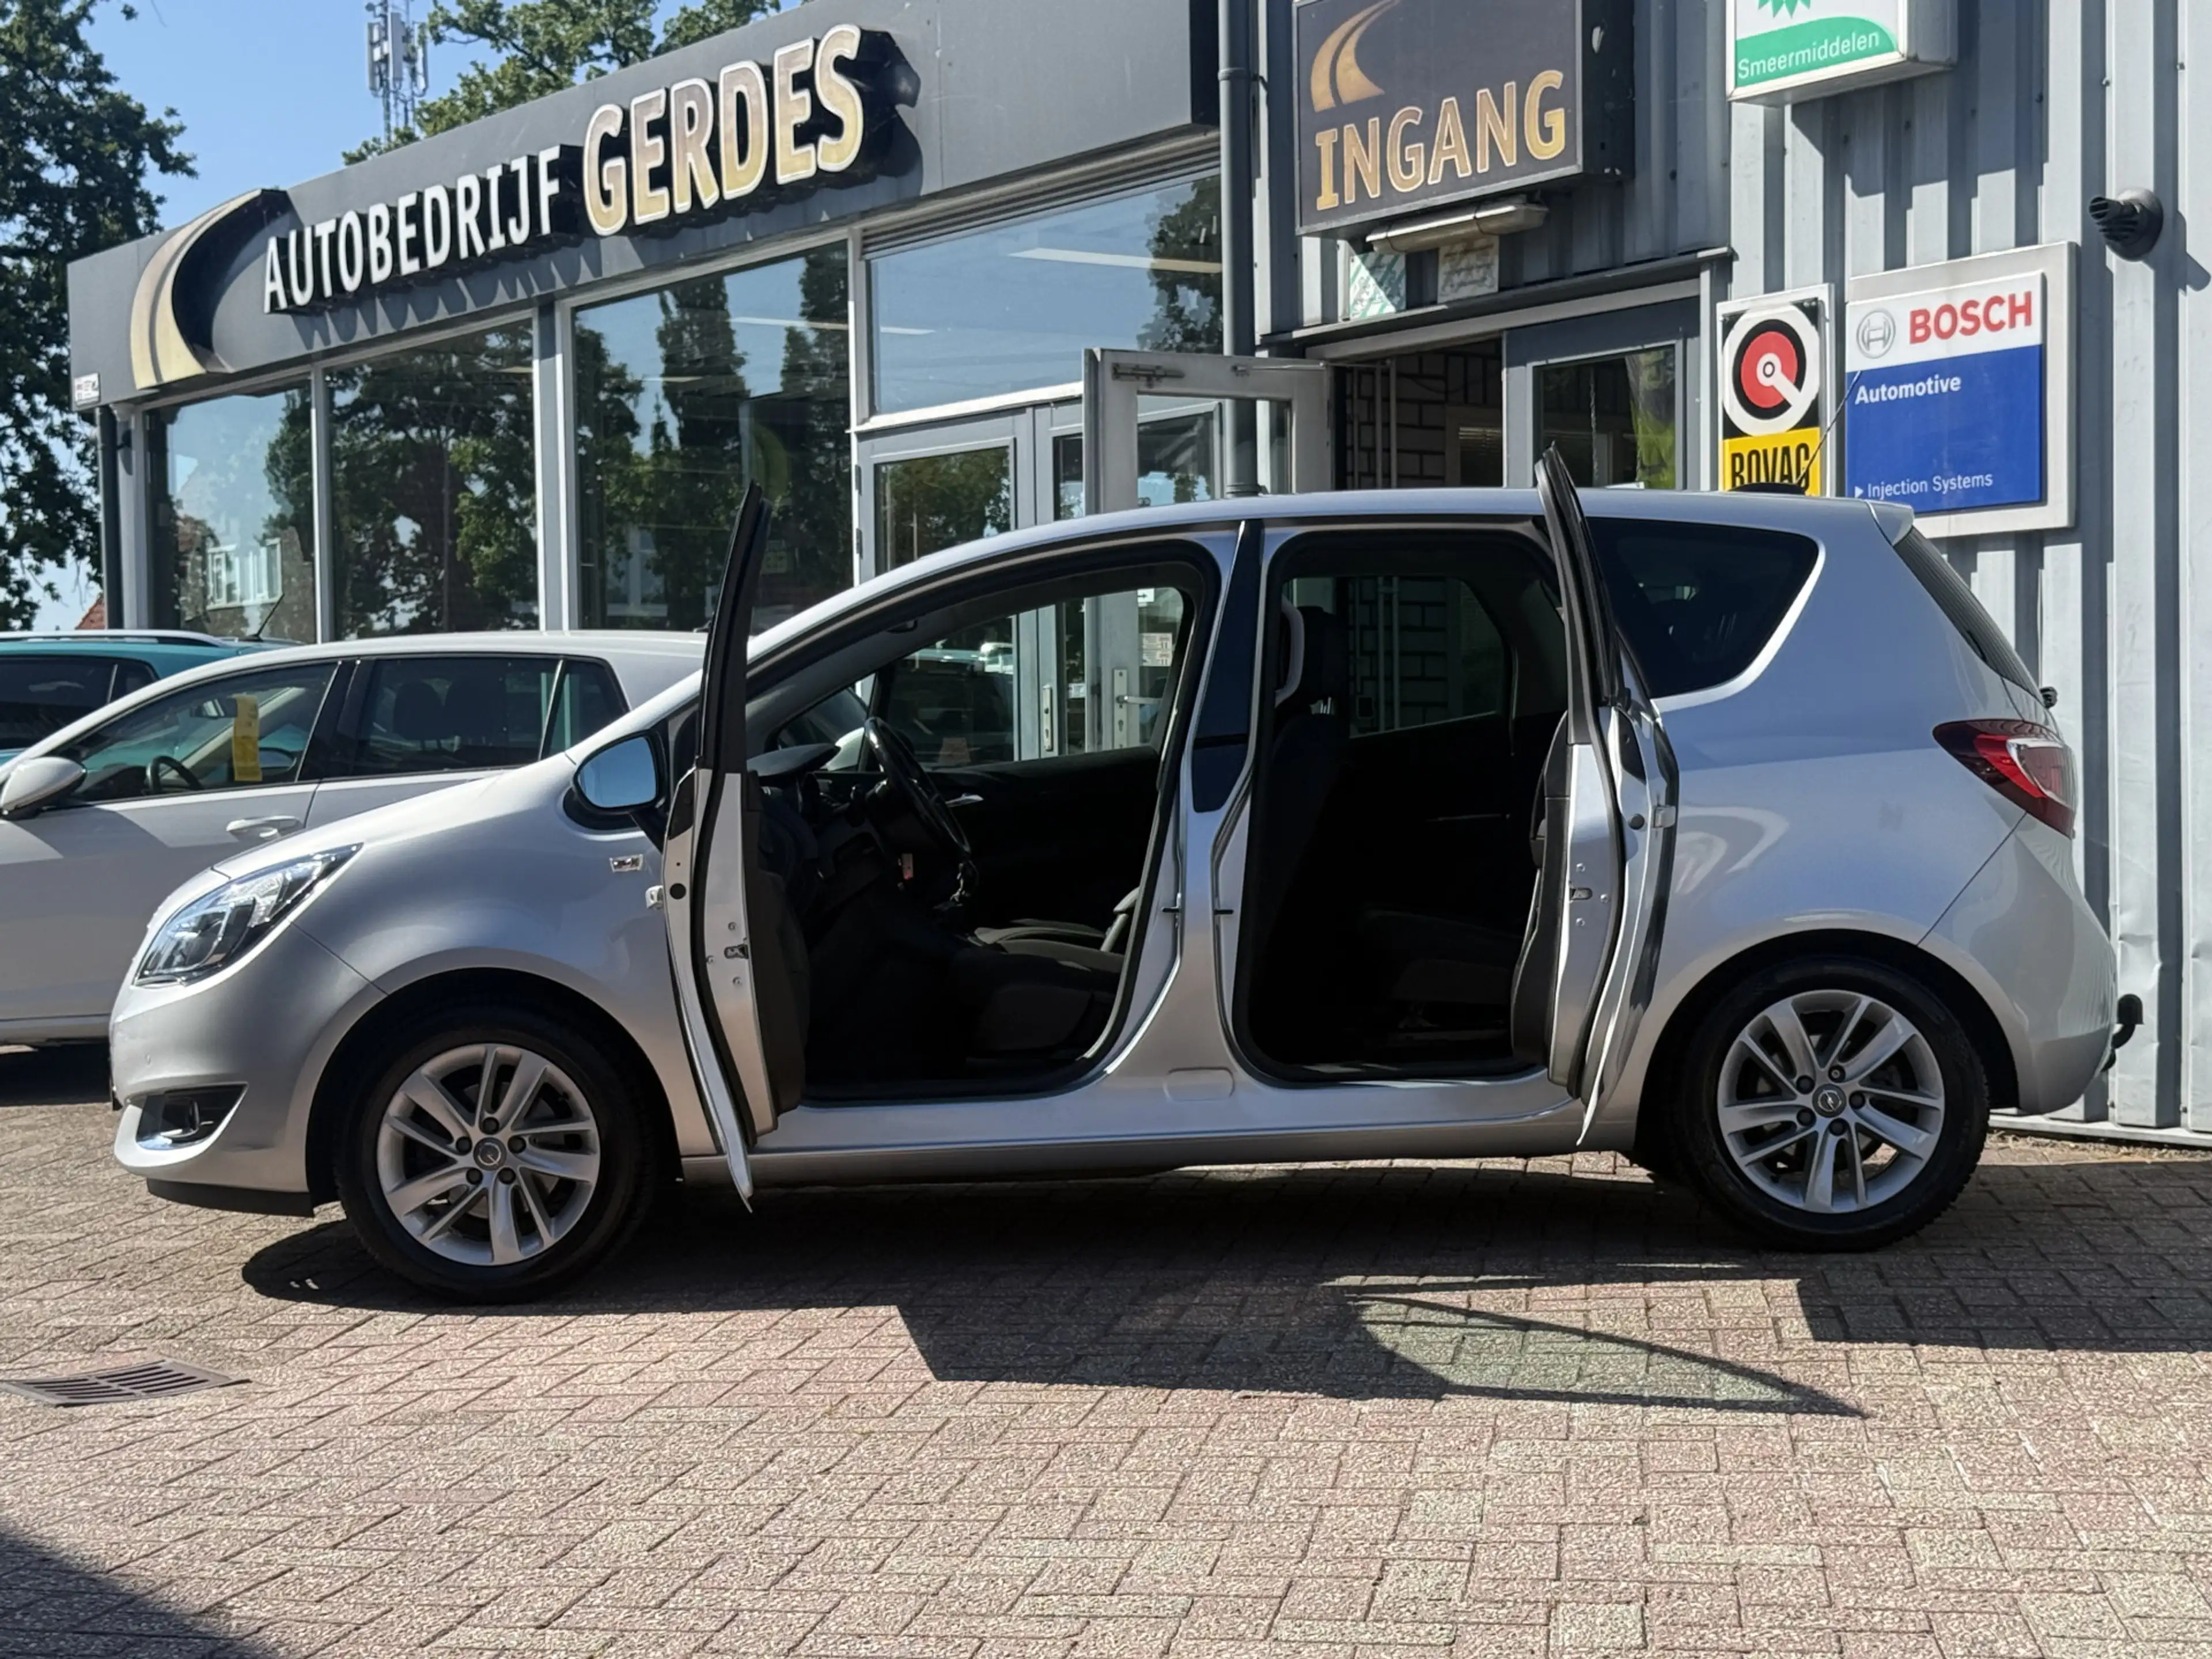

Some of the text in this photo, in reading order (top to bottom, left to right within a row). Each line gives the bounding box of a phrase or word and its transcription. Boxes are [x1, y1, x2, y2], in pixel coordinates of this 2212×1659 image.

[1737, 32, 1880, 79] Smeermiddelen
[1316, 70, 1566, 210] INGANG
[264, 24, 864, 313] AUTOBEDRIJF GERDES
[1909, 291, 2032, 344] BOSCH
[1855, 375, 1961, 404] Automotive
[1731, 442, 1810, 491] BOVAG
[1868, 474, 1993, 501] Injection Systems
